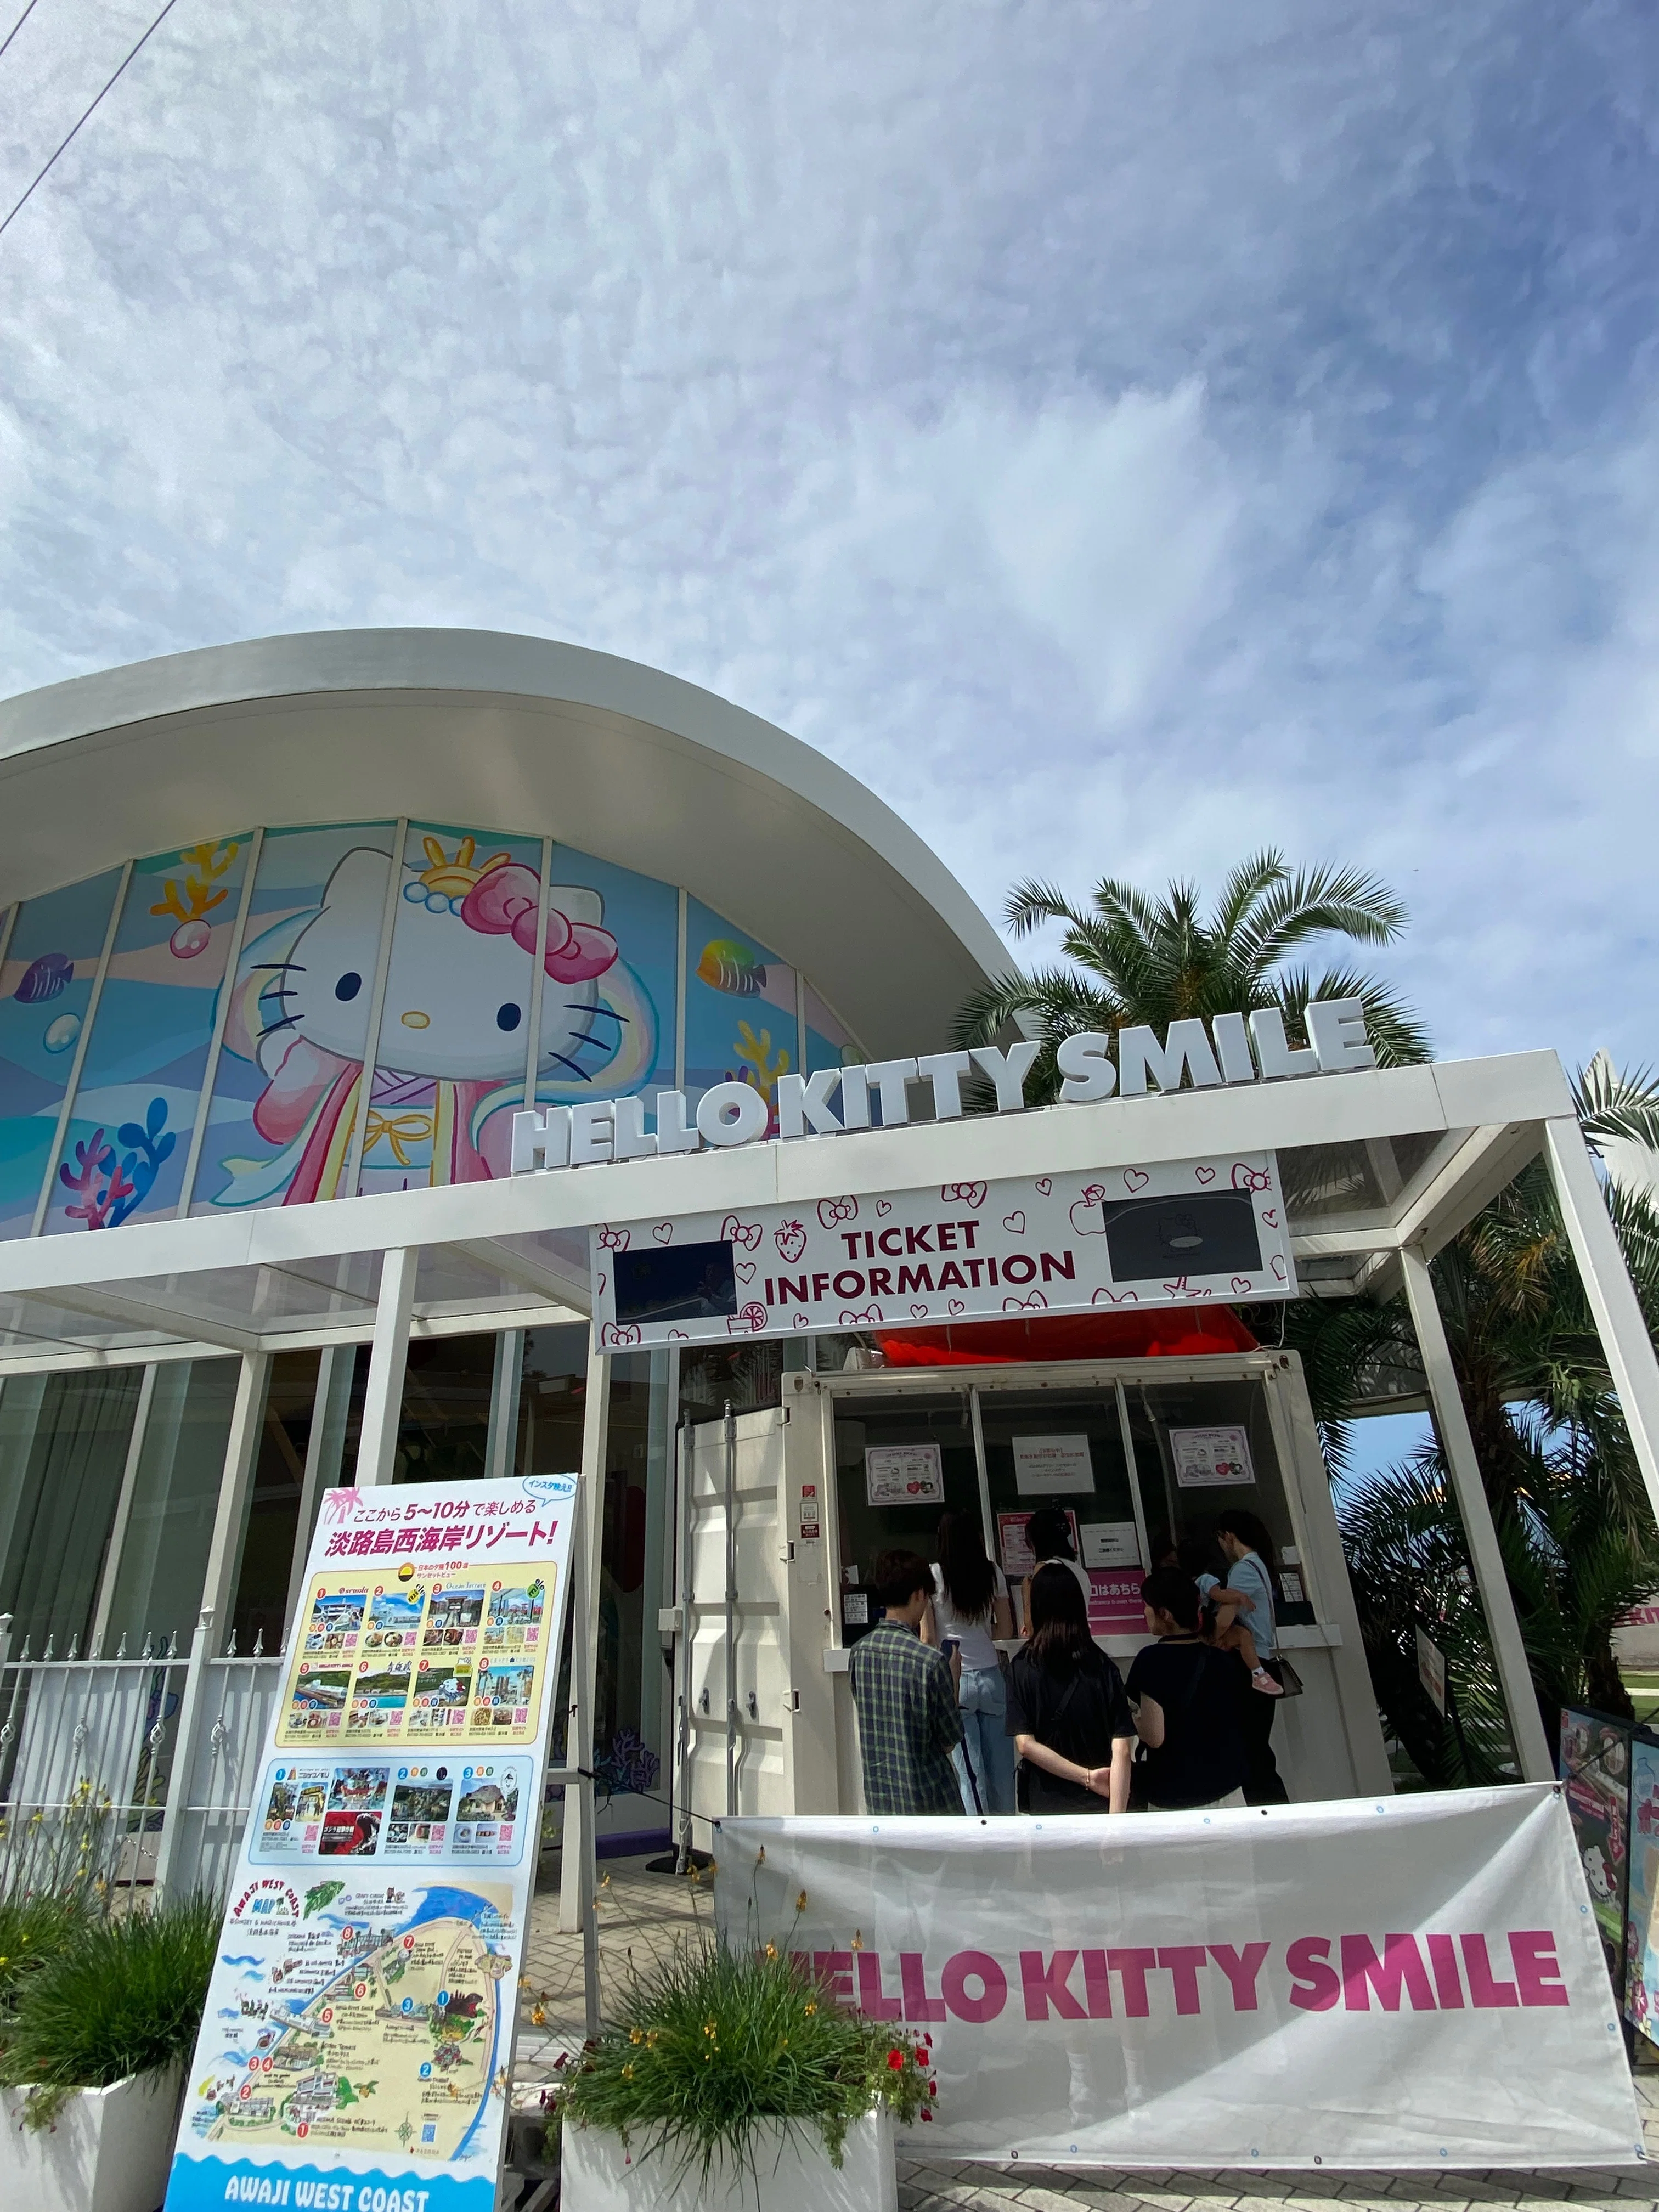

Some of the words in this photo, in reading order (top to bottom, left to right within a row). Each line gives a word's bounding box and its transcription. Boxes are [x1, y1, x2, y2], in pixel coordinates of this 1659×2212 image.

[511, 1081, 769, 1175] HELLO
[779, 1040, 1042, 1139] KITTY
[1058, 996, 1378, 1103] SMILE
[841, 1218, 980, 1261] TICKET
[765, 1250, 1076, 1306] INFORMATION
[324, 1520, 558, 1558] 淡路島西海岸リゾート!
[1090, 1583, 1141, 1598] 口はあちら
[251, 1898, 276, 1915] MAP
[1019, 1940, 1272, 2022] KITTY
[1286, 1929, 1570, 2012] SMILE
[224, 2175, 291, 2205] AWAJI
[295, 2181, 354, 2211] WEST
[358, 2186, 430, 2212] COAST
